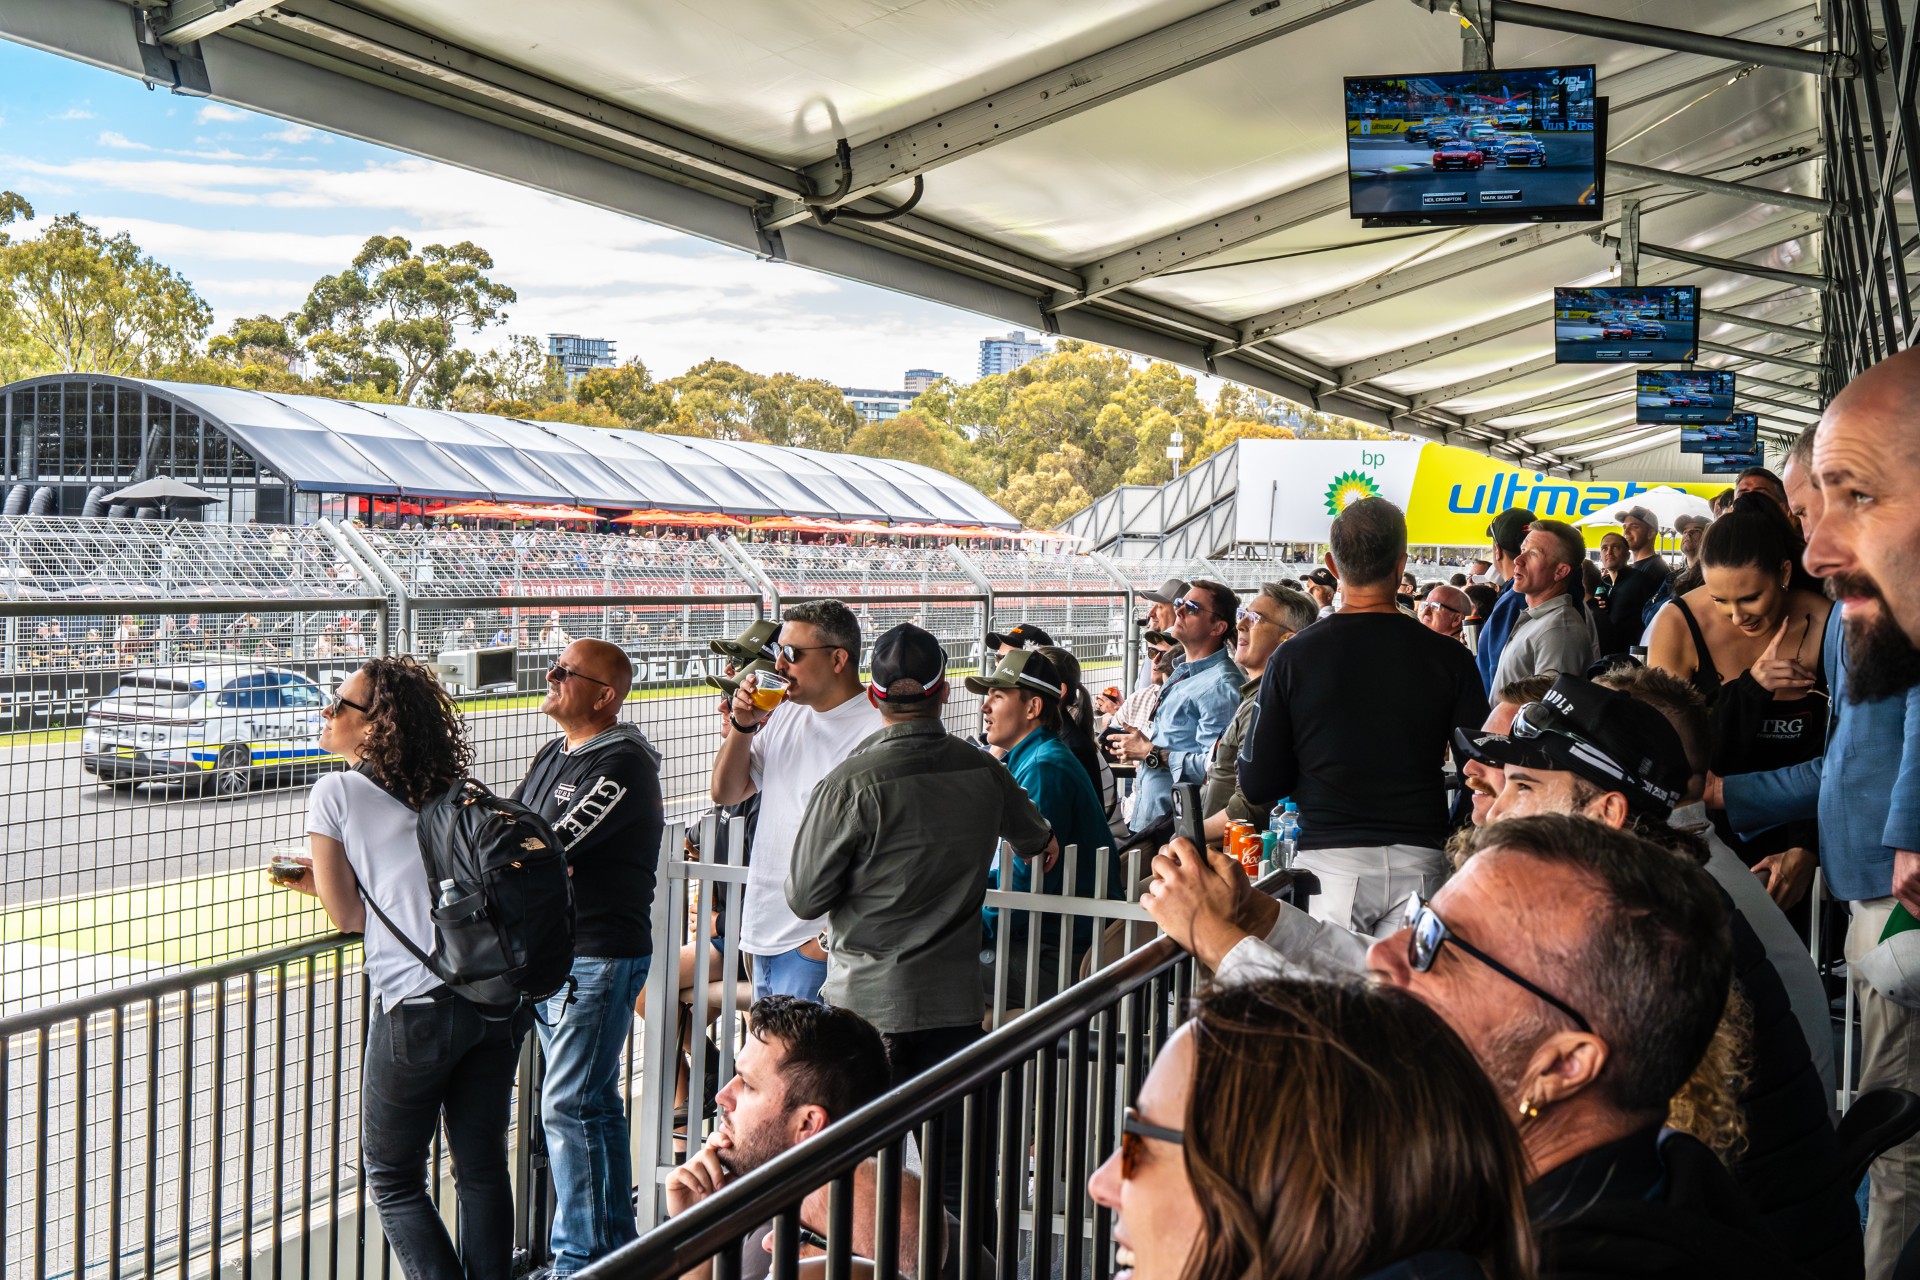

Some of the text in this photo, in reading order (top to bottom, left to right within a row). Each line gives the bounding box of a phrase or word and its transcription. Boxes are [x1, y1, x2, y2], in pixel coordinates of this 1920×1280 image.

[1568, 119, 1594, 131] PIES
[1363, 449, 1385, 469] bp
[1448, 473, 1687, 515] ultimat
[1762, 718, 1804, 733] TRG
